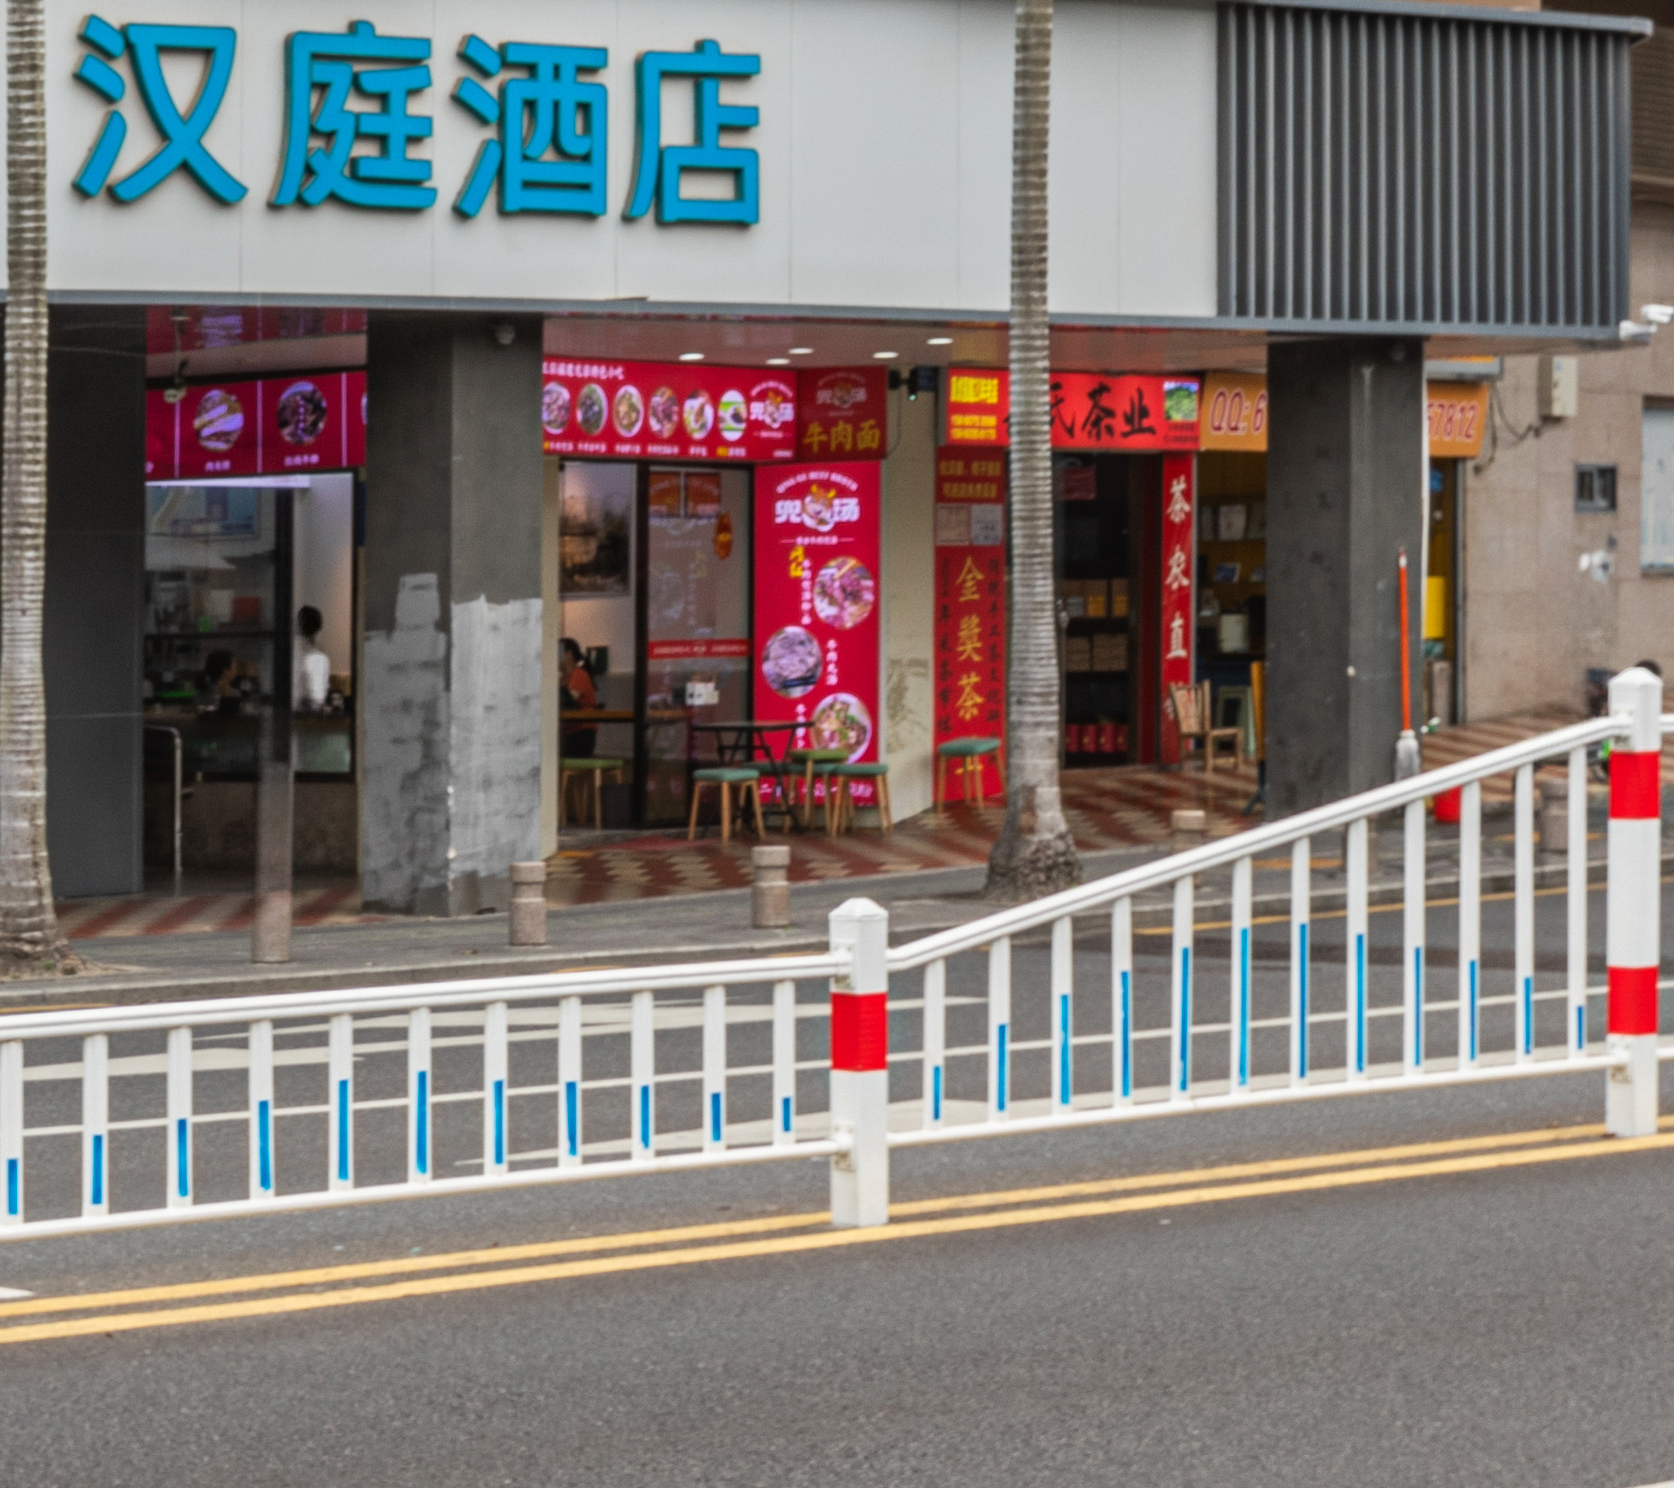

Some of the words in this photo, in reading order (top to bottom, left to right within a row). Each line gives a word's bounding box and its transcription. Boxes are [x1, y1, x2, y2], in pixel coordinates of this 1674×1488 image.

[72, 14, 761, 224] 汉庭酒店
[803, 420, 881, 453] 牛肉面
[1004, 381, 1156, 441] 氏茶业
[1165, 473, 1192, 722] 茶农直
